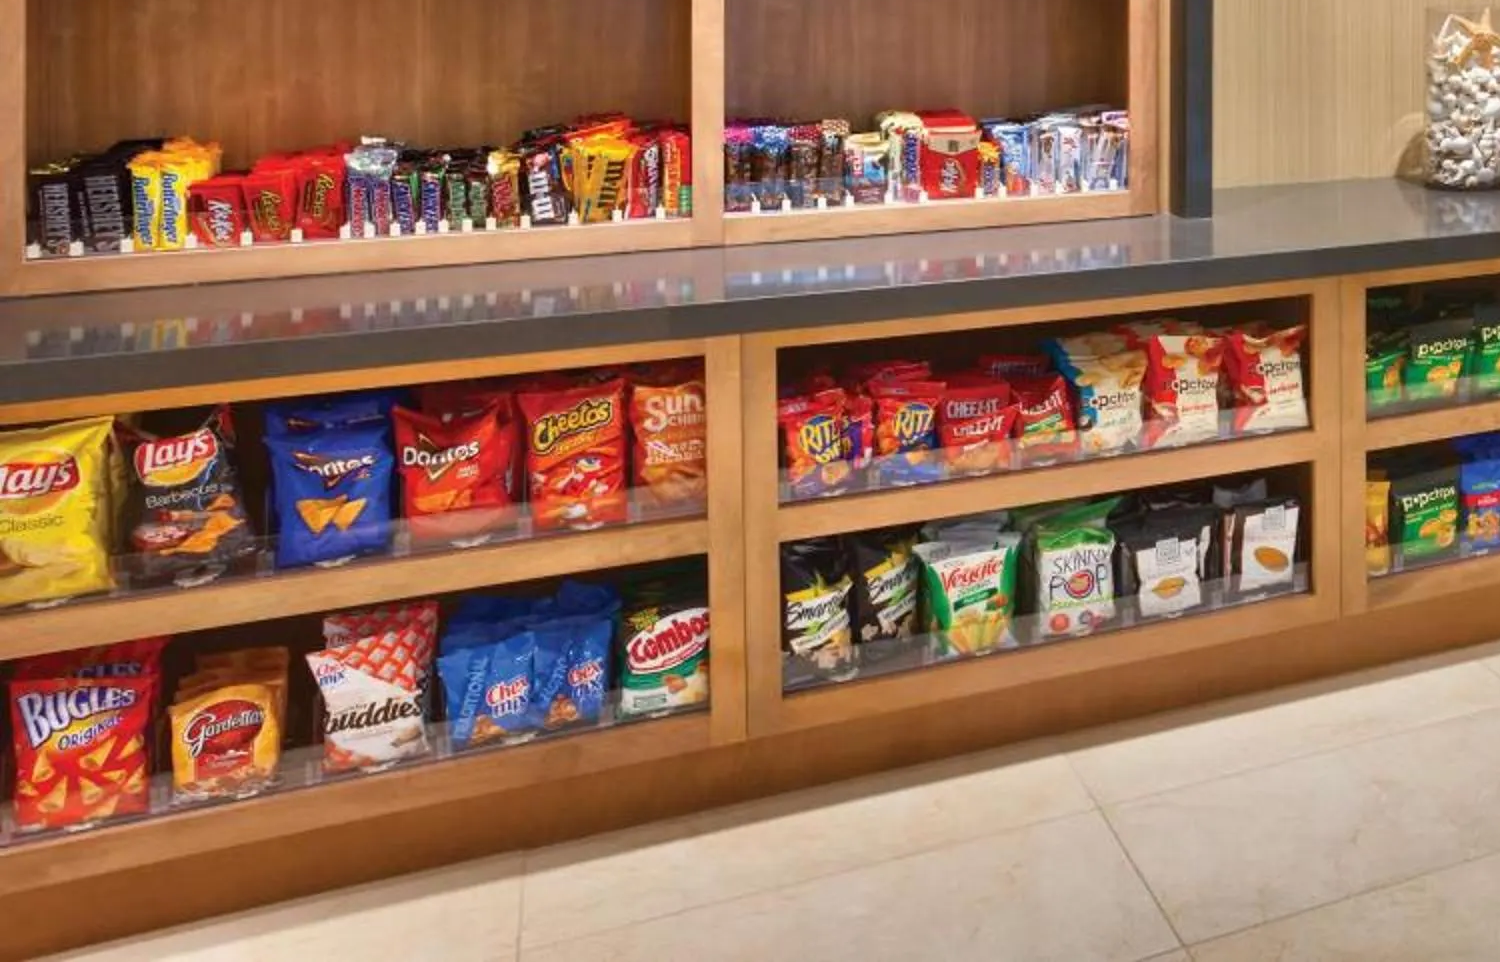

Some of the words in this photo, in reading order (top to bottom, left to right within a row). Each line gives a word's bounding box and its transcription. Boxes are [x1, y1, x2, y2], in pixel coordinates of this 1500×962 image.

[532, 399, 611, 452] Cheetos
[643, 392, 704, 432] Sun
[892, 409, 935, 436] RITZ
[403, 441, 479, 466] Doritos
[1053, 548, 1109, 574] SKINNY
[18, 688, 137, 749] BUGLES
